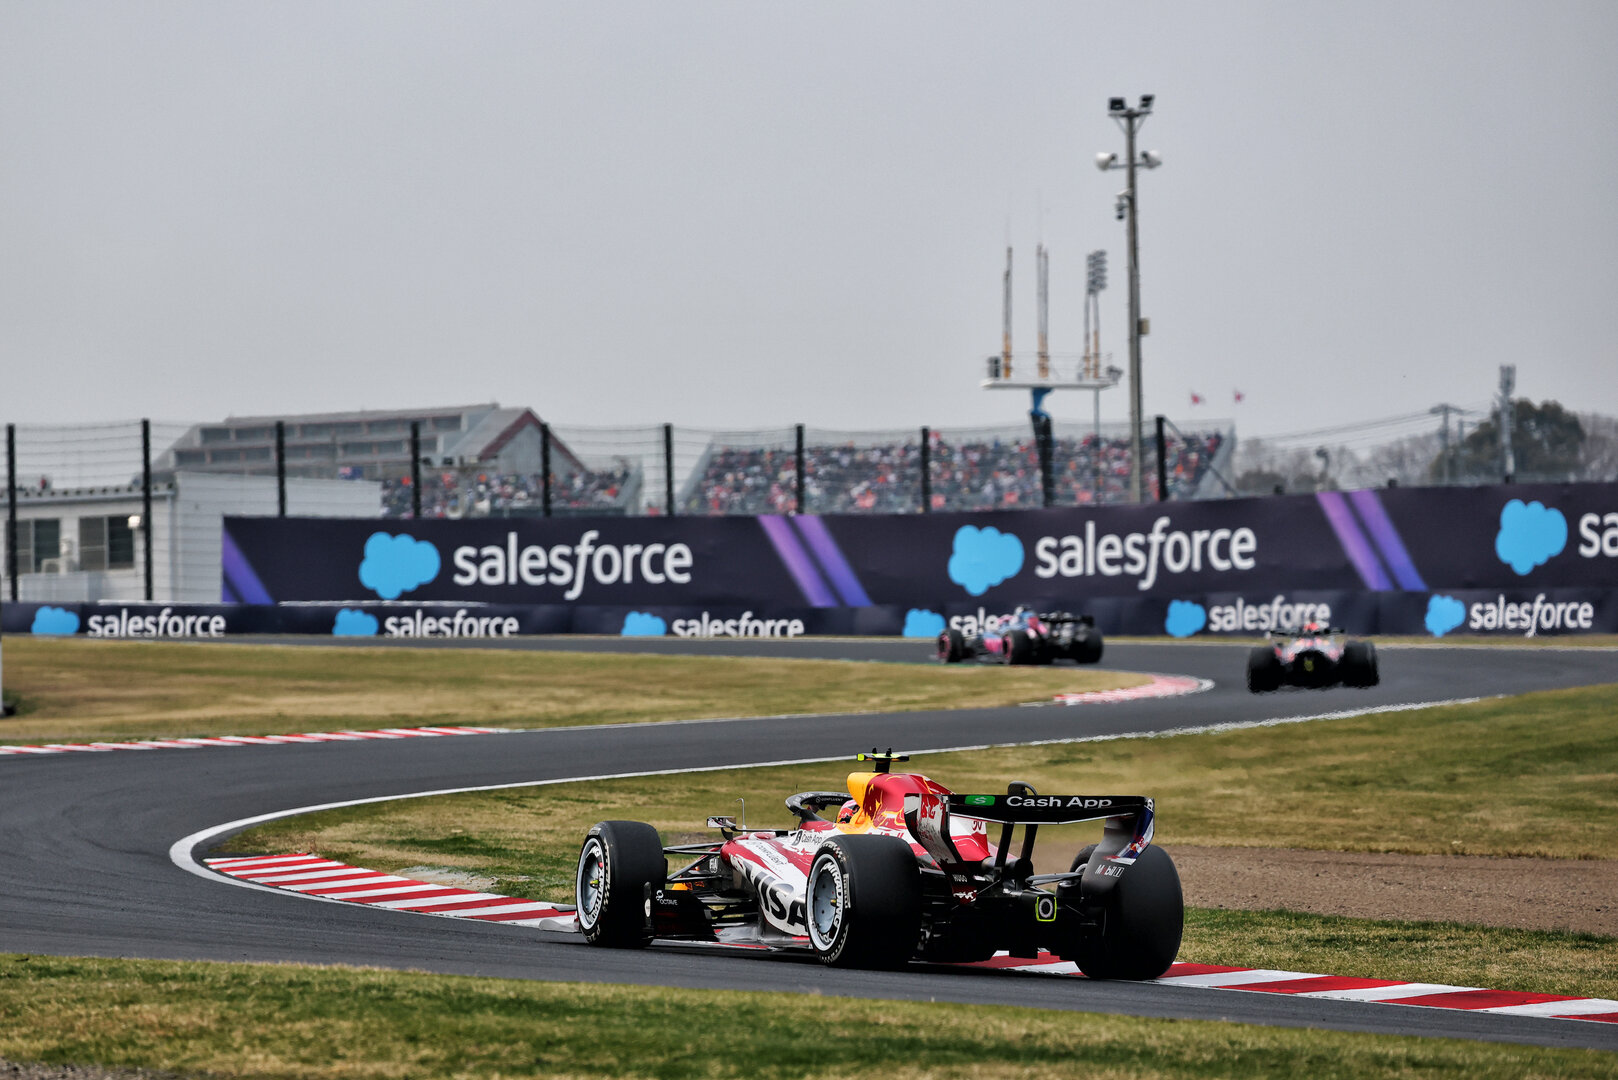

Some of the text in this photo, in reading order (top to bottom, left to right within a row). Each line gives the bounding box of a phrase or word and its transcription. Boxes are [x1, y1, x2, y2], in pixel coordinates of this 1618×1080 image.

[453, 529, 693, 600] salesforce
[1035, 516, 1257, 591] salesforce
[87, 607, 226, 637] salesforce
[384, 609, 520, 638] salesforce
[672, 611, 804, 638] salesforce
[1208, 595, 1330, 631] salesforce
[1469, 593, 1594, 638] salesforce
[1006, 796, 1061, 807] Cash
[1066, 796, 1113, 809] App
